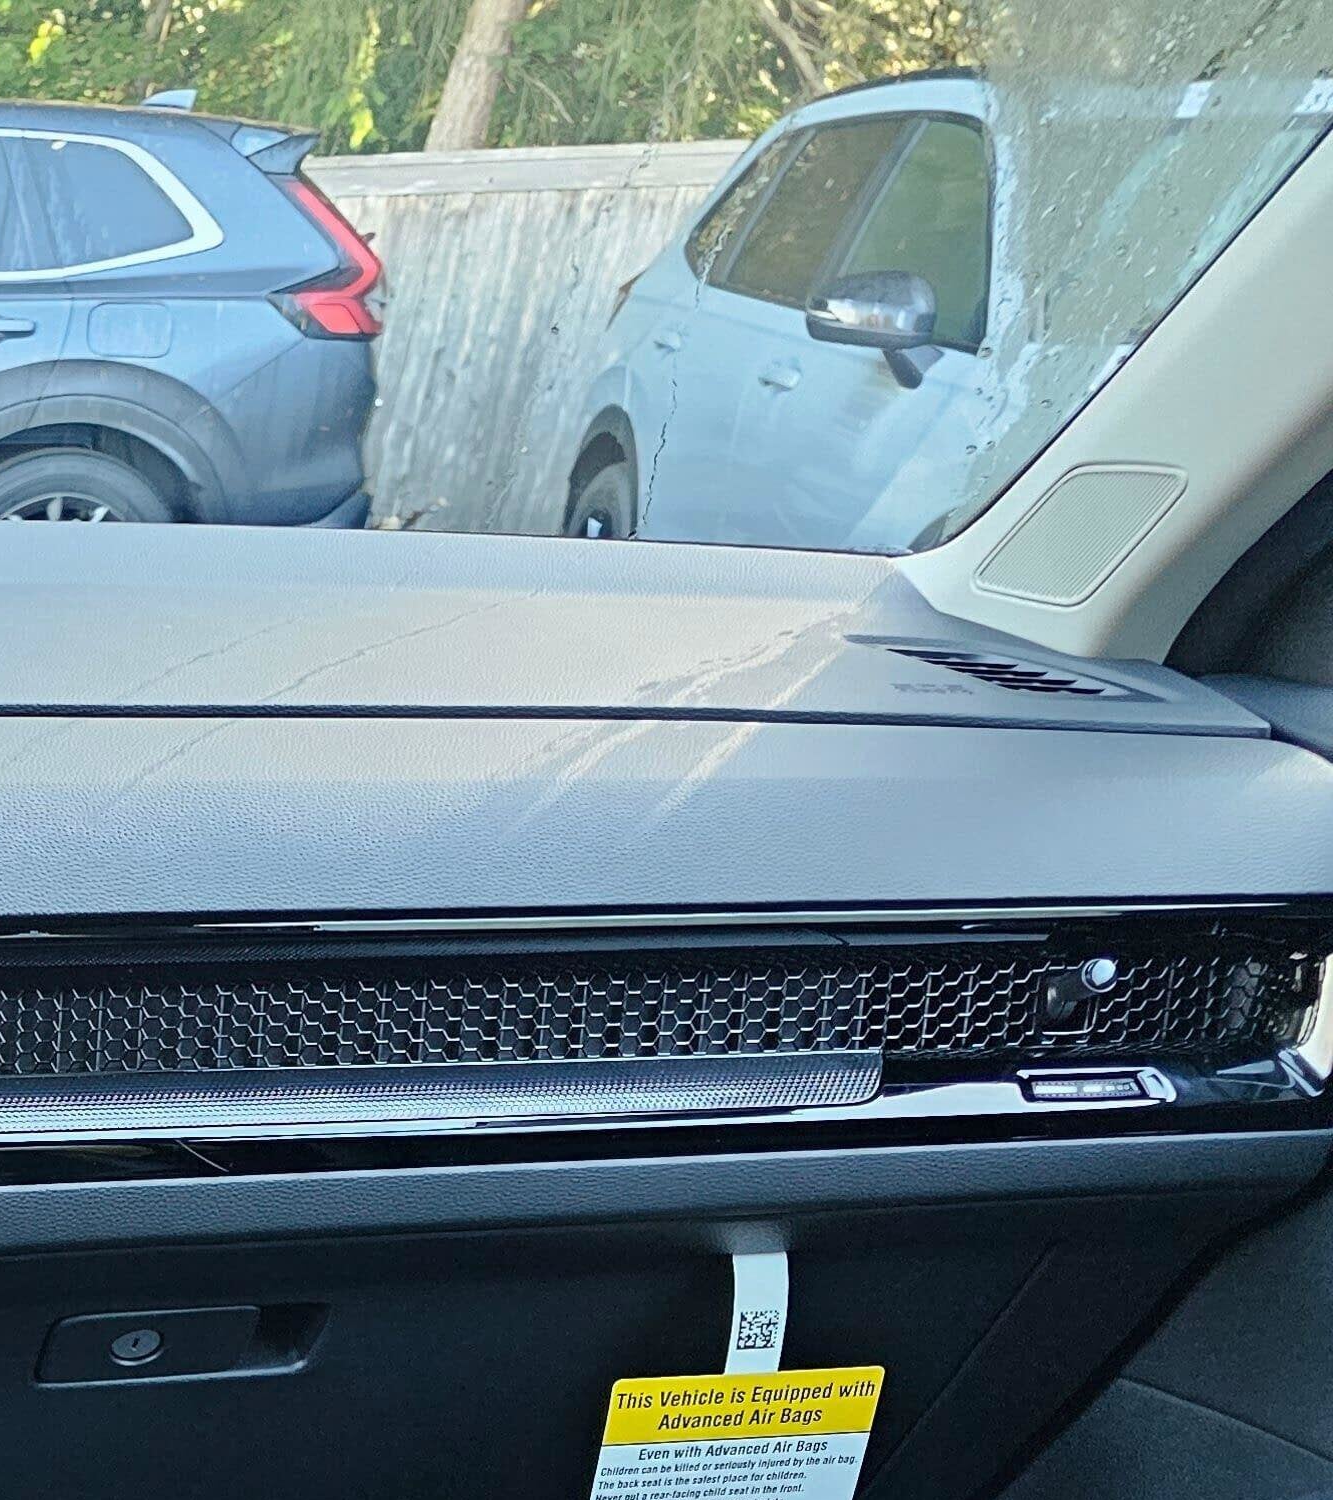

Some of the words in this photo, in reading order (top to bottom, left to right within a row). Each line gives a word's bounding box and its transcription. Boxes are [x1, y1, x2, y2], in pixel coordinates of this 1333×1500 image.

[617, 1392, 653, 1409] This
[660, 1389, 724, 1407] Vehicle
[730, 1388, 746, 1404] is
[751, 1382, 834, 1405] Equipped
[839, 1380, 875, 1398] with
[658, 1410, 744, 1430] Advanced
[748, 1409, 775, 1425] Air
[780, 1407, 823, 1425] Bags
[639, 1448, 670, 1461] Even
[674, 1446, 702, 1459] with
[705, 1443, 770, 1458] Advanced
[772, 1441, 792, 1454] Air
[796, 1440, 828, 1453] Bags
[600, 1466, 639, 1477] Children
[641, 1466, 658, 1474] can
[660, 1465, 672, 1473] be
[674, 1462, 700, 1472] killed
[702, 1463, 712, 1471] or
[714, 1460, 757, 1470] seriously
[758, 1459, 791, 1469] injured
[793, 1457, 804, 1467] by
[806, 1456, 820, 1465] the
[823, 1455, 837, 1464] air
[838, 1455, 857, 1465] bag.
[598, 1481, 614, 1490] The
[617, 1479, 638, 1489] back
[641, 1478, 662, 1487] seat
[664, 1478, 673, 1486] is
[675, 1477, 690, 1485] the
[692, 1475, 721, 1484] safest
[722, 1474, 748, 1484] place
[750, 1473, 764, 1481] for
[766, 1471, 807, 1480] children.
[650, 1490, 701, 1500] rear-facing
[703, 1488, 727, 1497] child
[728, 1487, 749, 1496] seat
[751, 1486, 761, 1494] in
[763, 1485, 777, 1494] the
[779, 1484, 805, 1493] front.
